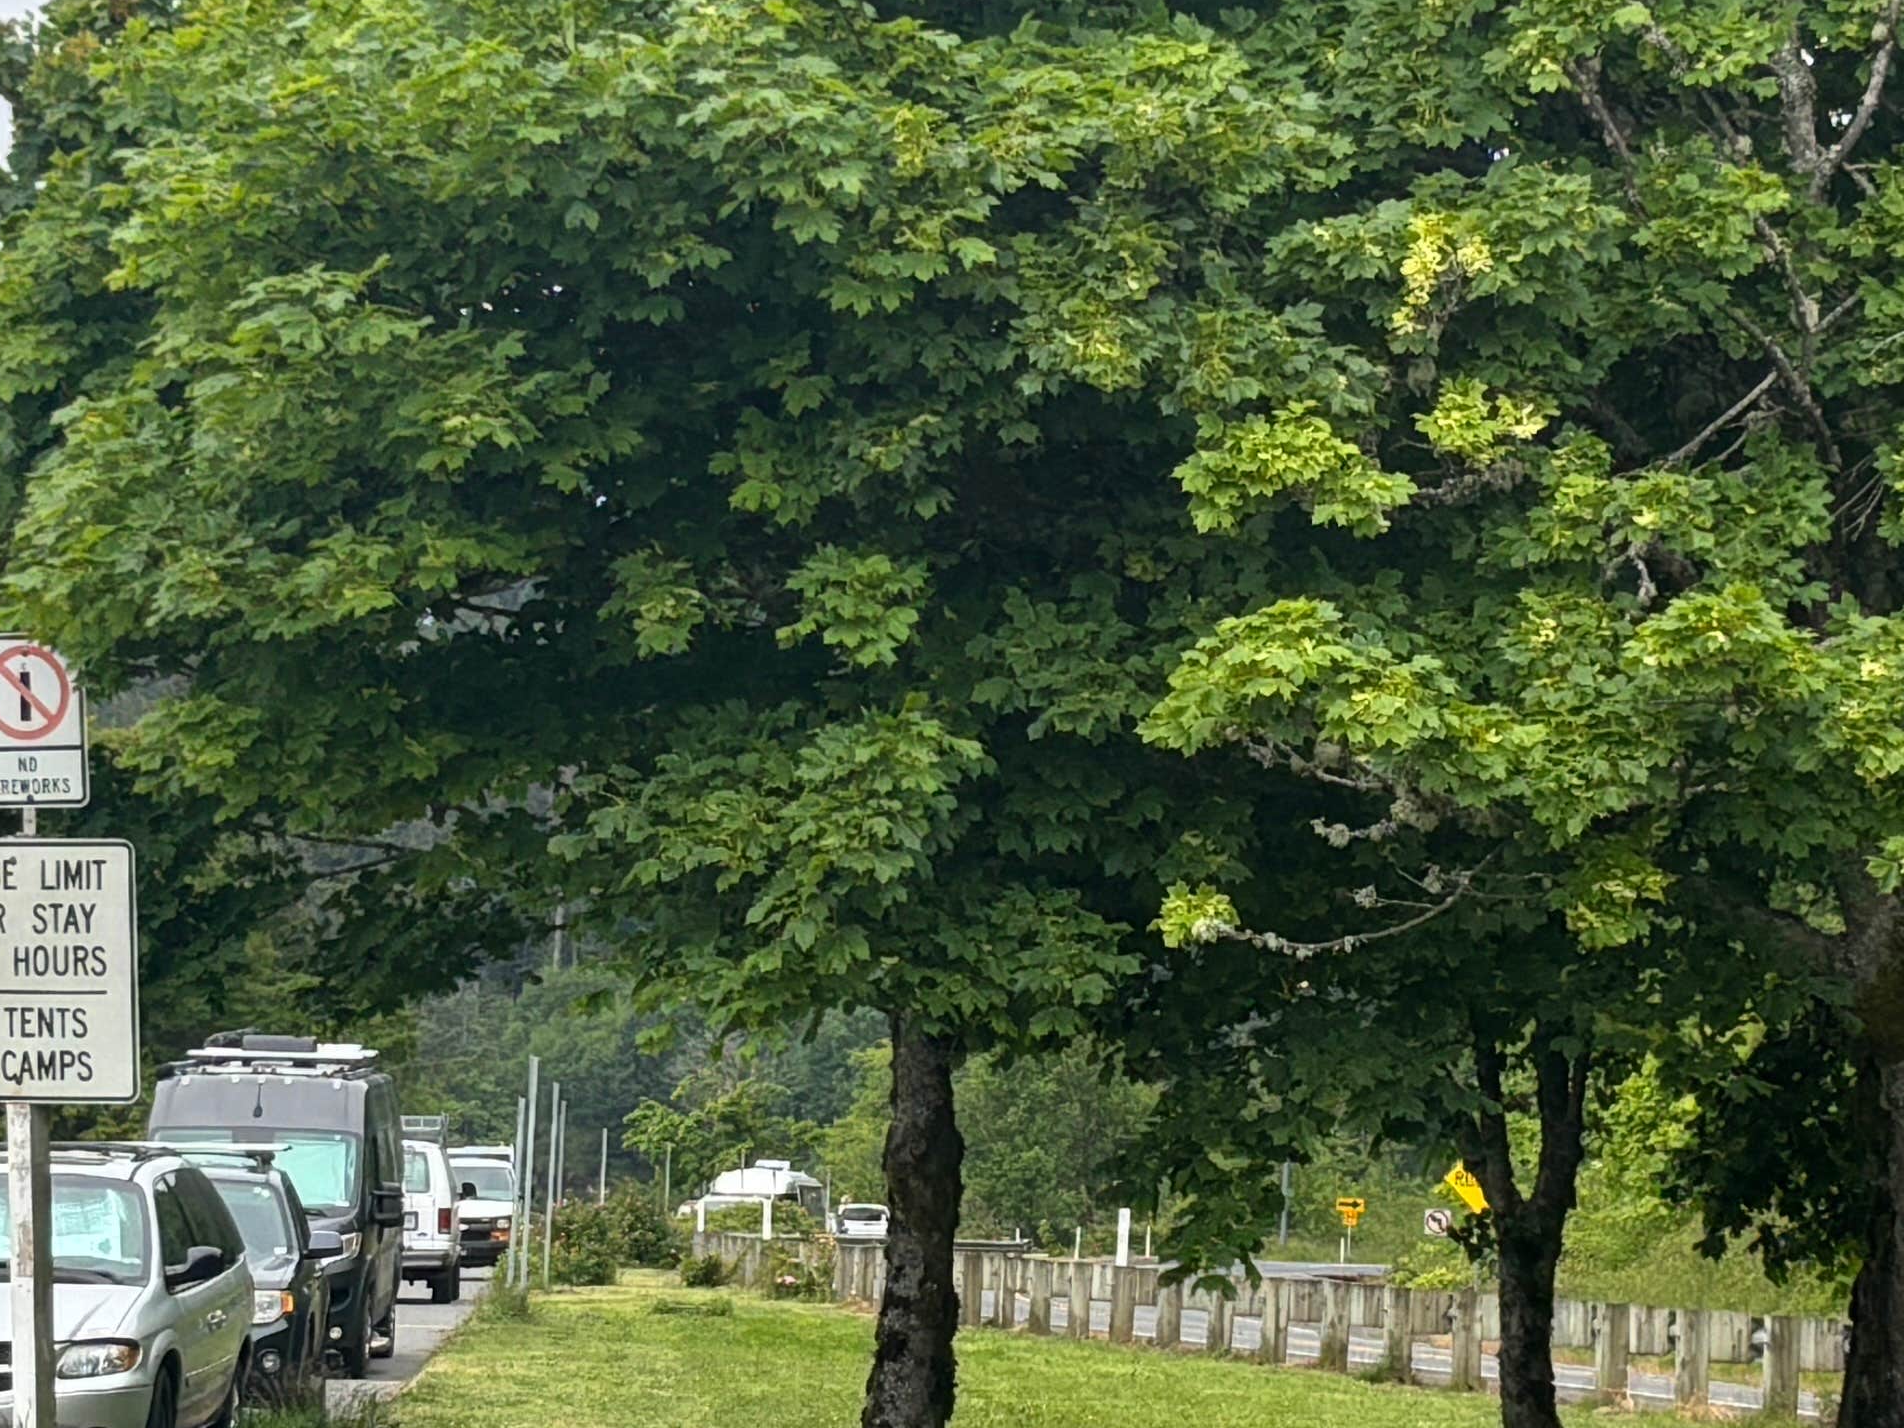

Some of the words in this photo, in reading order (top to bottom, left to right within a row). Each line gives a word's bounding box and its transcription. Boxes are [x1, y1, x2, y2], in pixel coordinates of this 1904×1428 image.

[17, 756, 38, 773] NO
[40, 859, 107, 891] LIMIT
[31, 902, 97, 935] STAY
[13, 944, 107, 977] HOURS
[3, 1006, 88, 1039] TENTS
[1, 1049, 93, 1082] CAMPS
